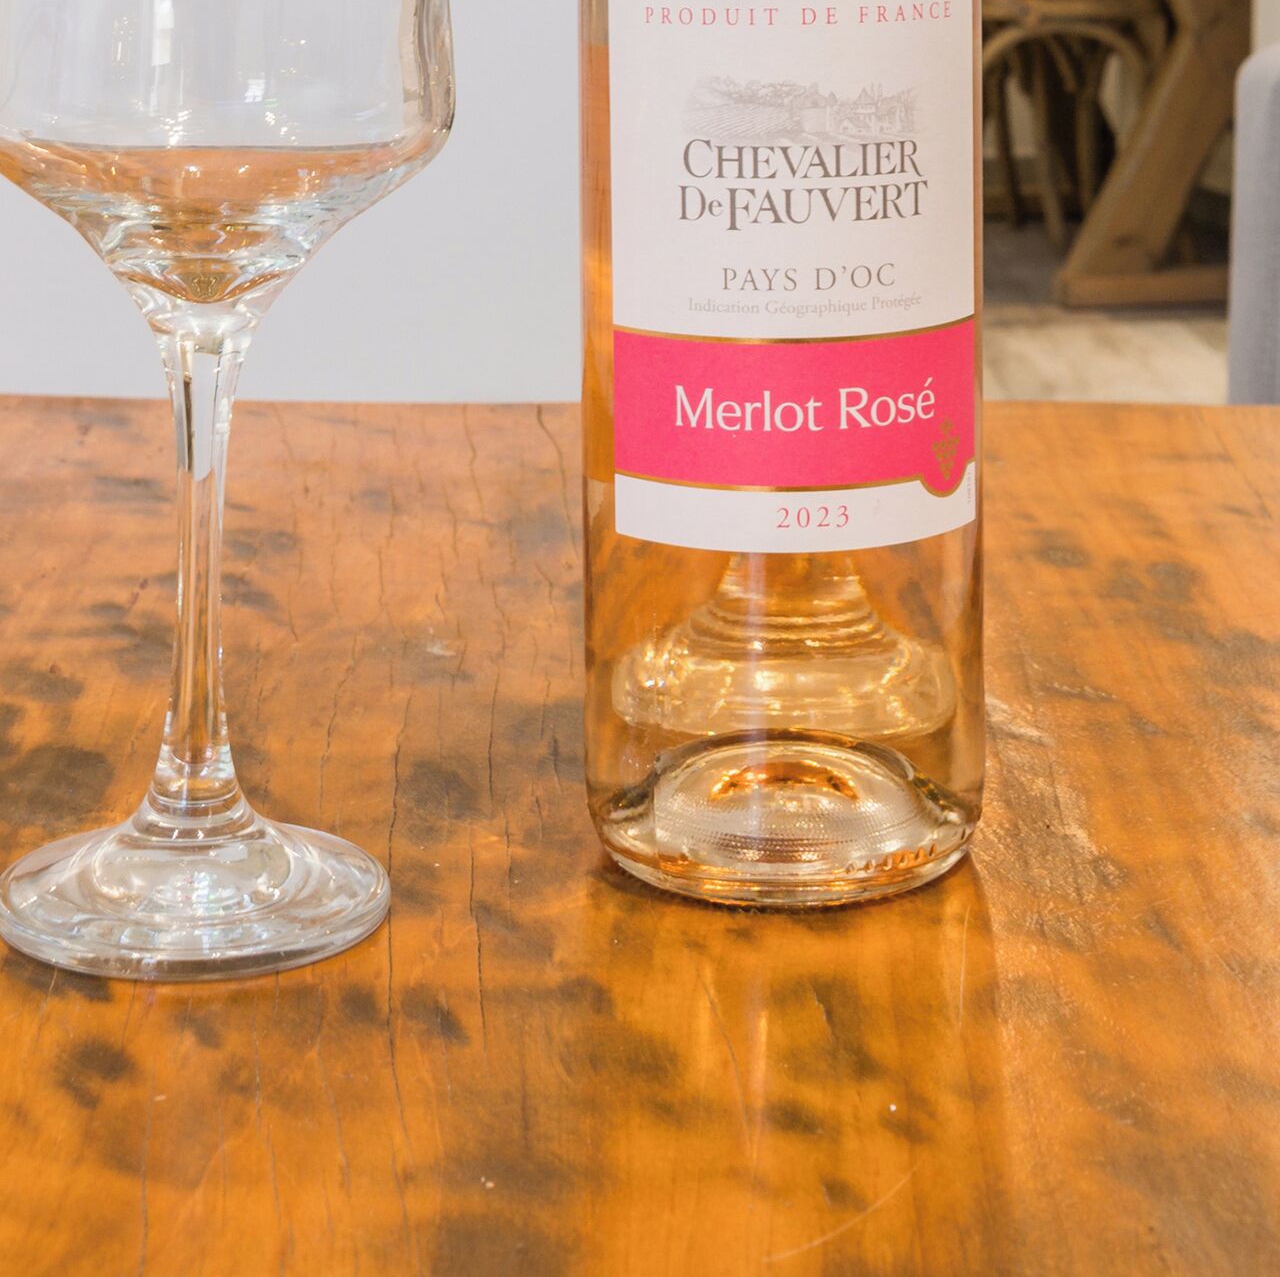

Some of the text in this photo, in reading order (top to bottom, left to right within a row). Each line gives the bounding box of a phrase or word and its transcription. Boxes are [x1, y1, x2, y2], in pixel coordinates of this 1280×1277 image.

[644, 0, 952, 26] PRODUIT DE FRANCE
[683, 139, 922, 179] CHEVALIER
[722, 263, 896, 291] PAYS D'OC
[688, 297, 760, 314] Indication
[764, 299, 867, 319] Géographique
[675, 377, 936, 431] Merlot Rosé
[776, 505, 850, 529] 2023
